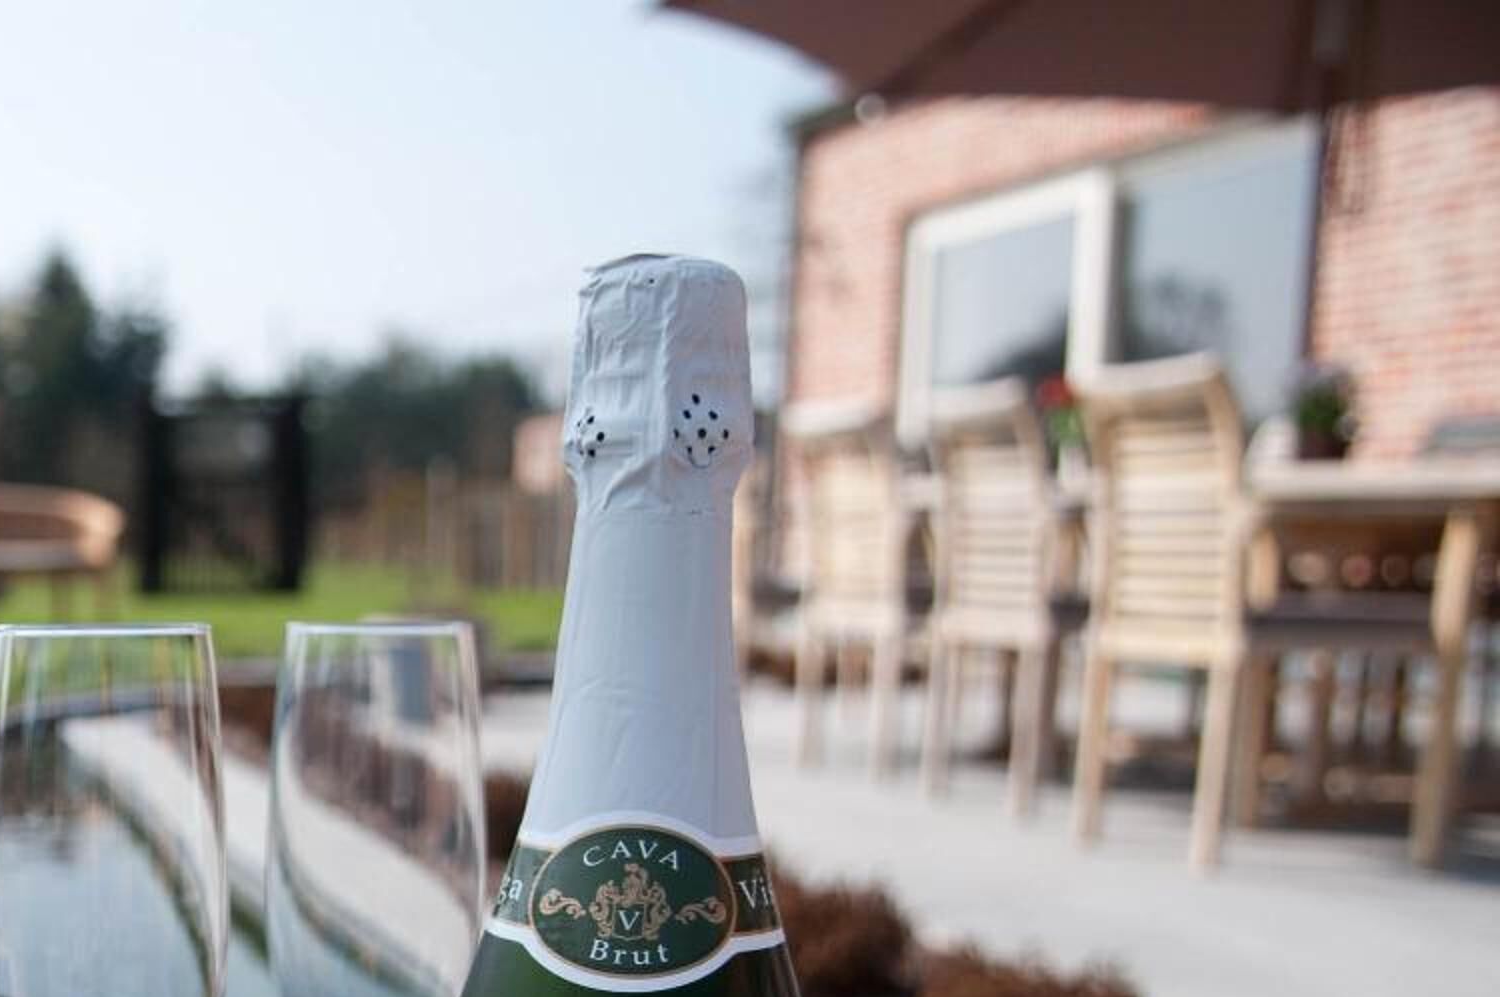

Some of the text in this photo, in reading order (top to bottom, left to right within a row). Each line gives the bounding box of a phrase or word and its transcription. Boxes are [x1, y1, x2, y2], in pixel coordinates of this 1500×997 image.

[583, 840, 679, 870] CAVA
[617, 911, 640, 930] V
[589, 938, 669, 965] Brut
